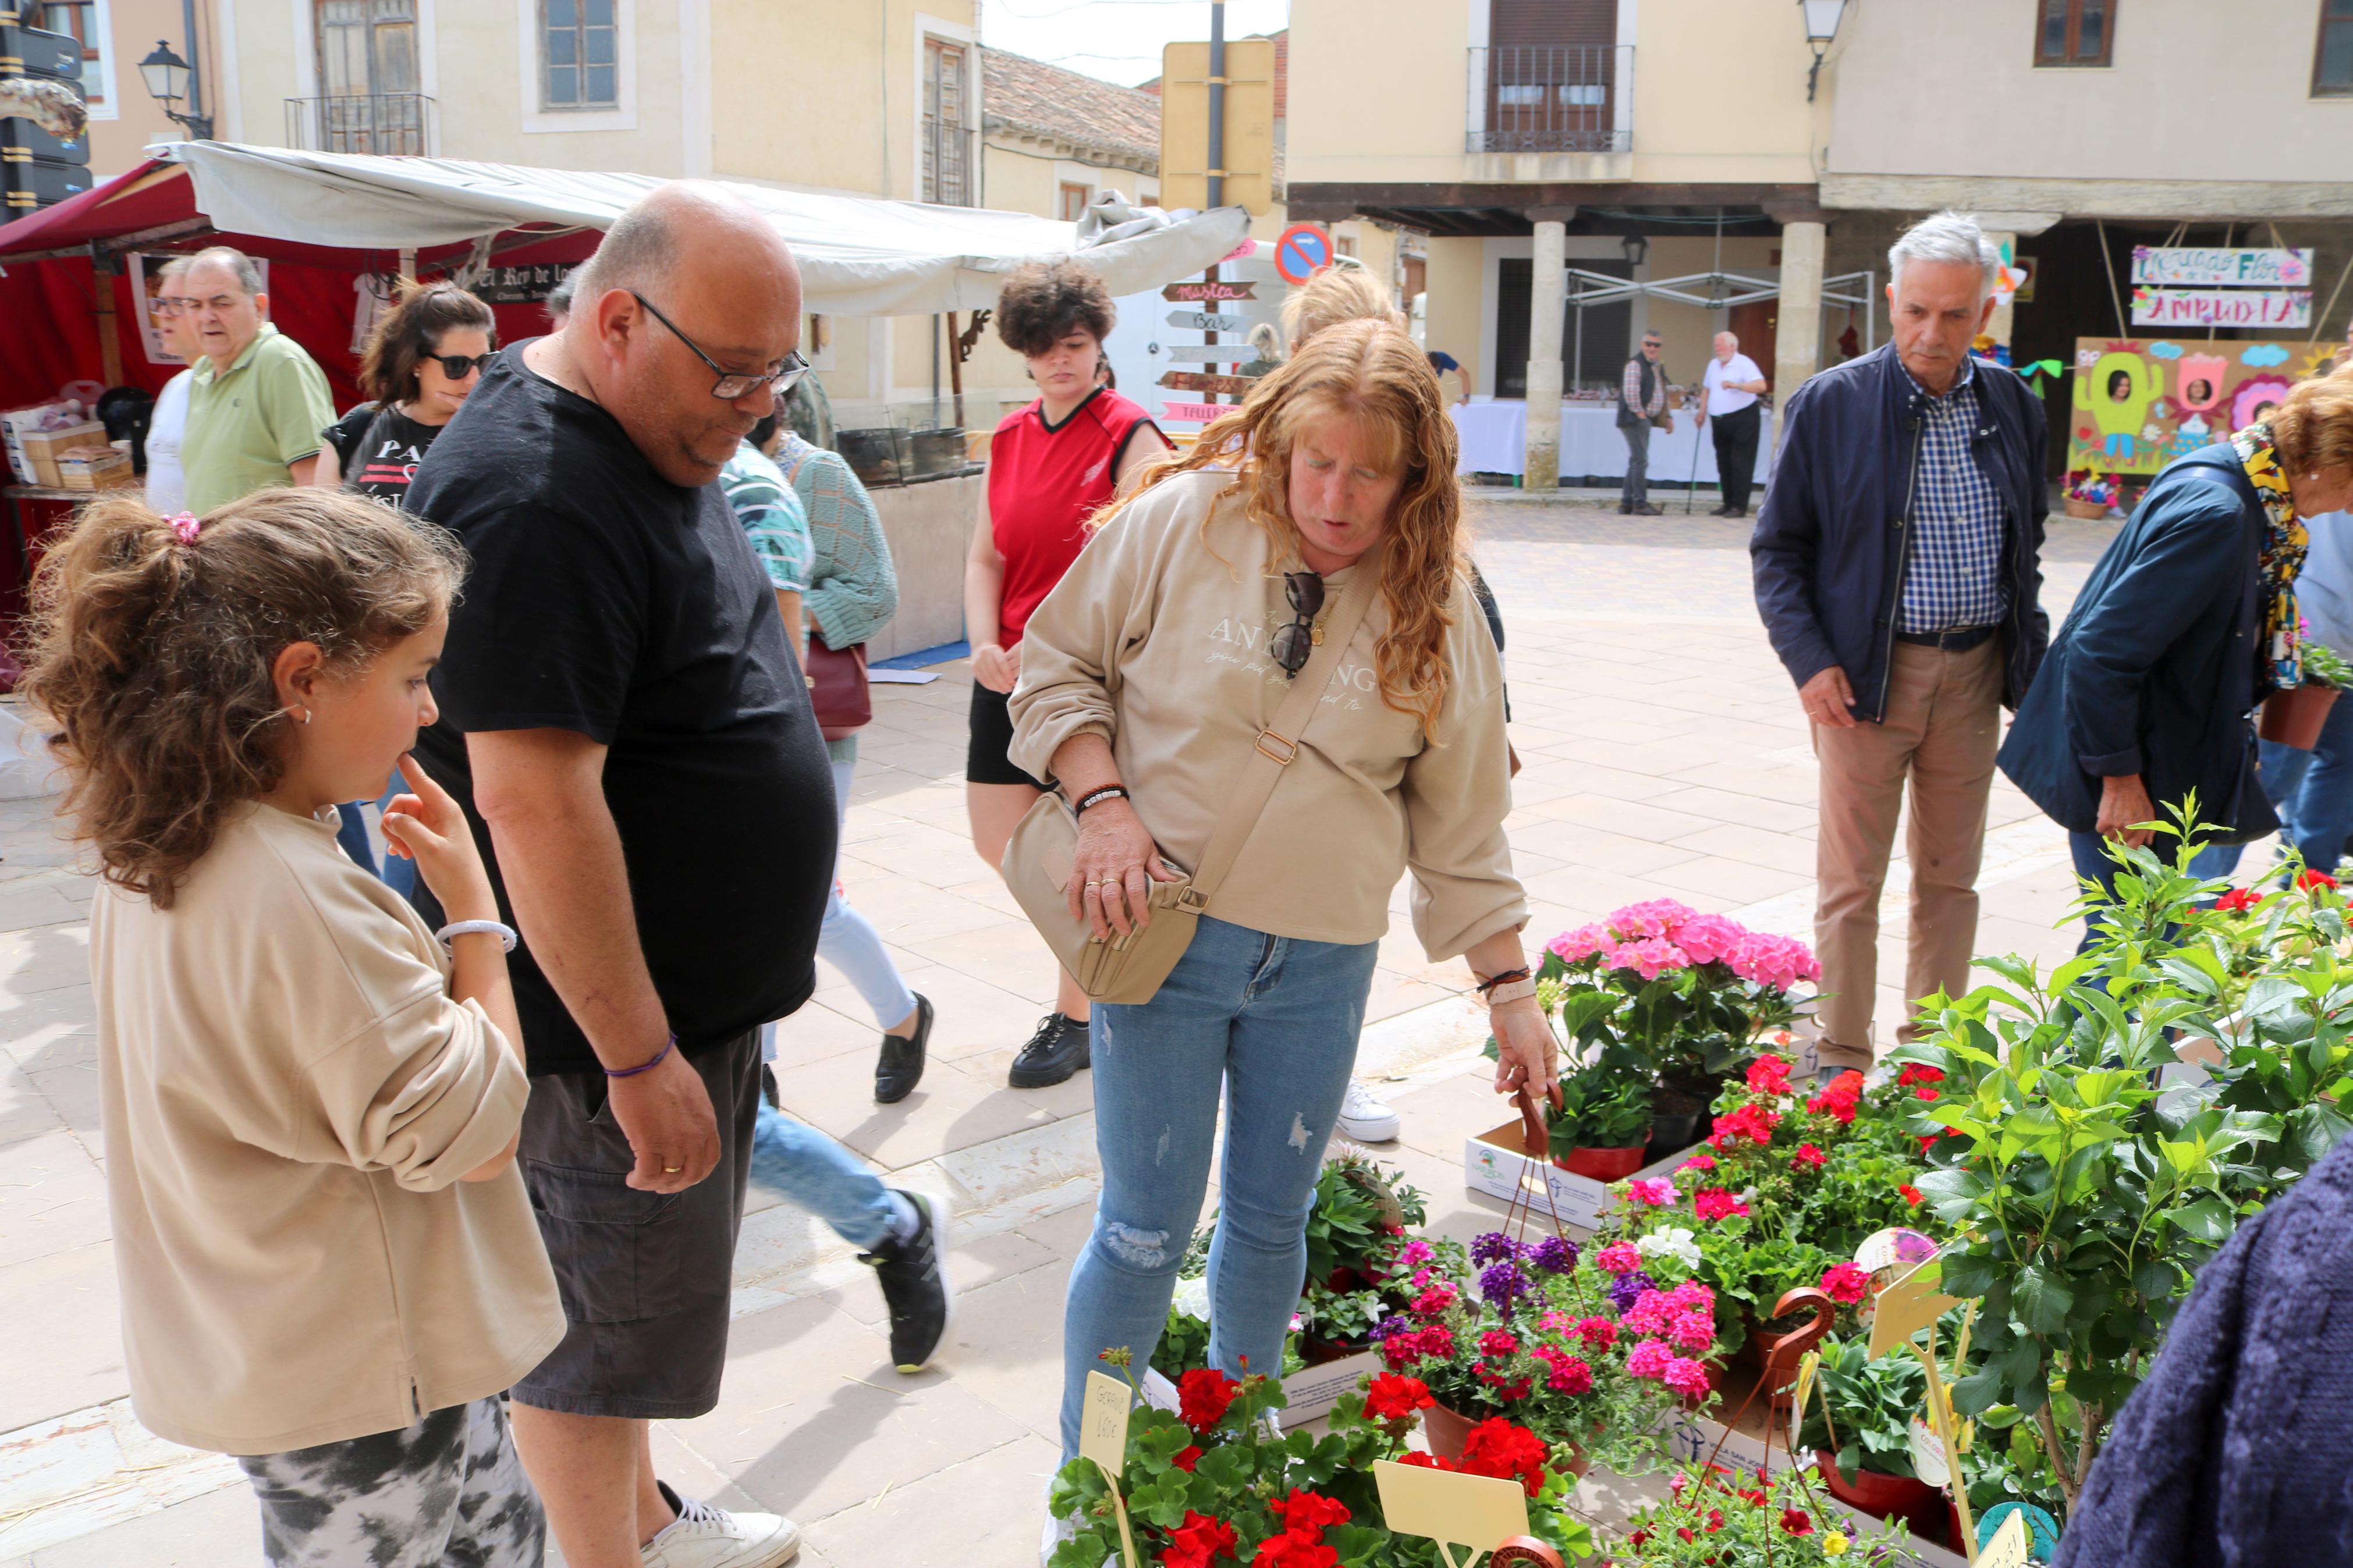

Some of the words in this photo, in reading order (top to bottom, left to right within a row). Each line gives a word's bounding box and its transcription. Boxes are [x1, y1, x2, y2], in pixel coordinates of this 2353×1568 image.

[503, 267, 530, 289] Rey
[534, 266, 549, 283] de
[2148, 296, 2295, 322] AMPUDIA
[1194, 312, 1236, 331] Bar
[1206, 651, 1240, 663] you
[1241, 662, 1271, 676] put
[1344, 698, 1362, 710] to
